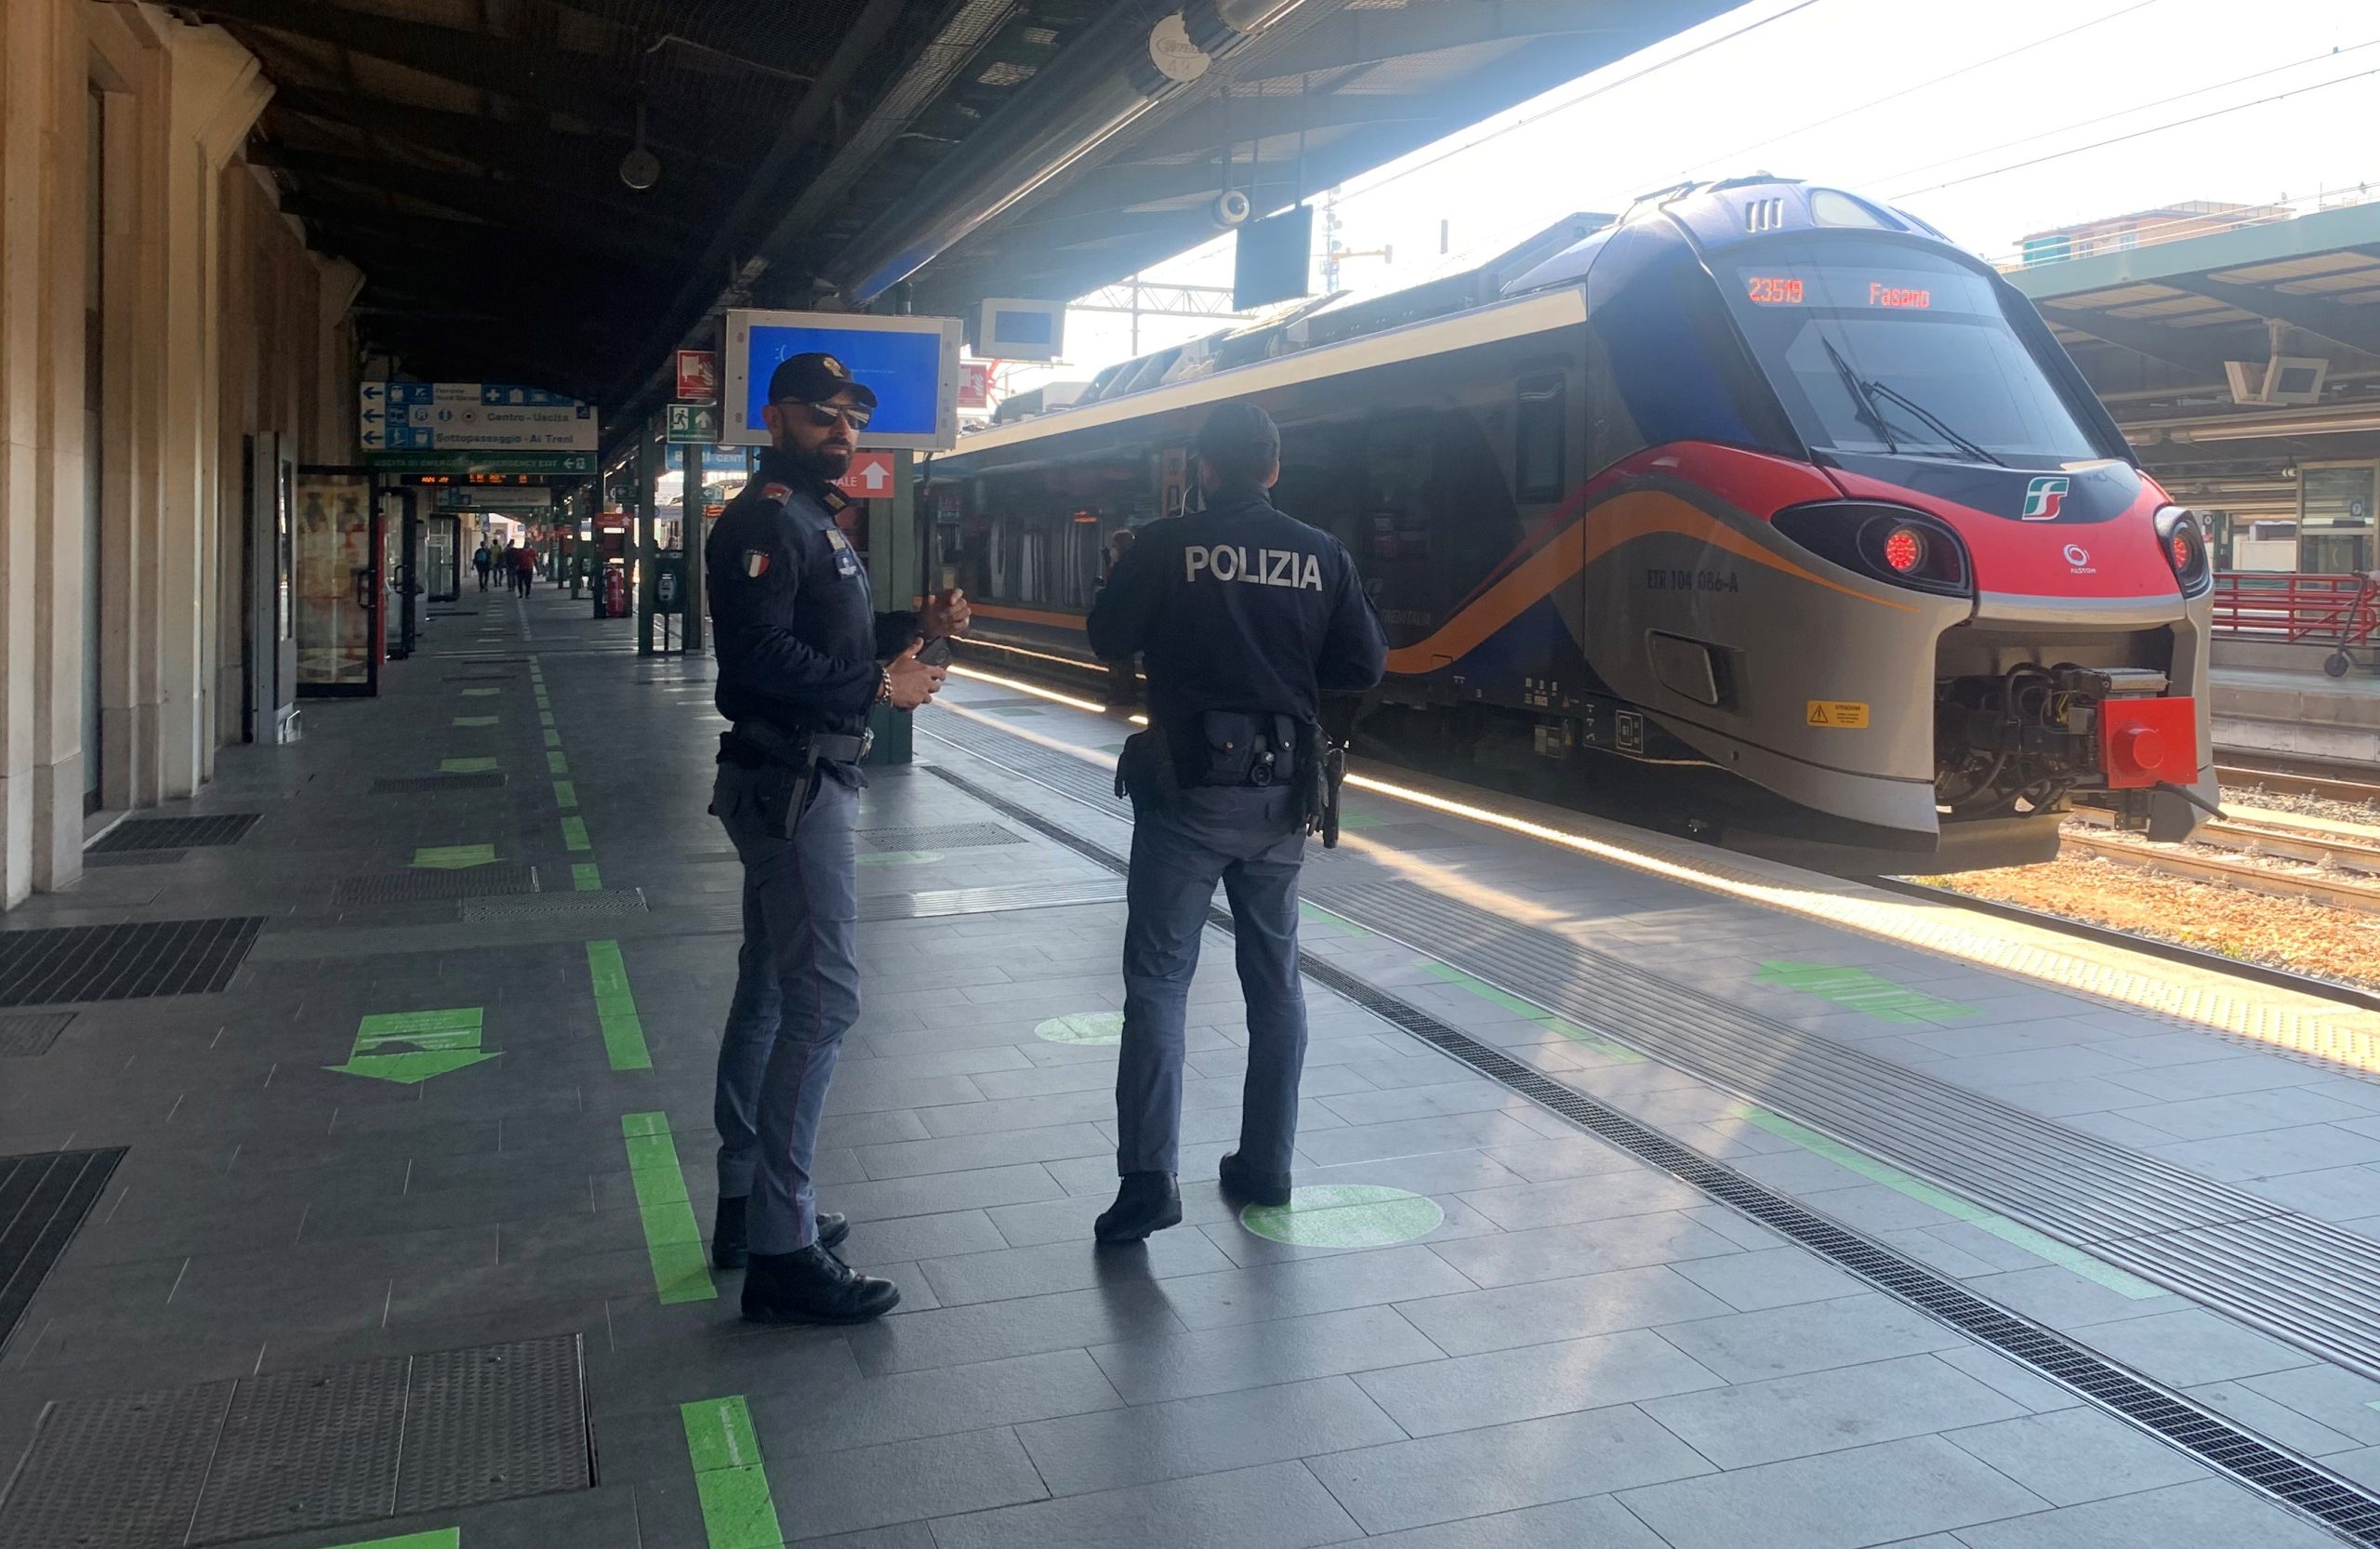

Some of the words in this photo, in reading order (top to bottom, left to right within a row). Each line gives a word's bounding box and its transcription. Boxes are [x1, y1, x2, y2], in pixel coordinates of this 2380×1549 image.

[1749, 278, 1804, 304] 23519
[1869, 282, 1930, 308] Fasano
[487, 412, 524, 422] Centro
[533, 412, 569, 422] Uscita
[546, 434, 574, 444] Treni
[1185, 544, 1323, 592] POLIZIA
[1647, 569, 1667, 589] ETR
[1672, 570, 1692, 590] 104
